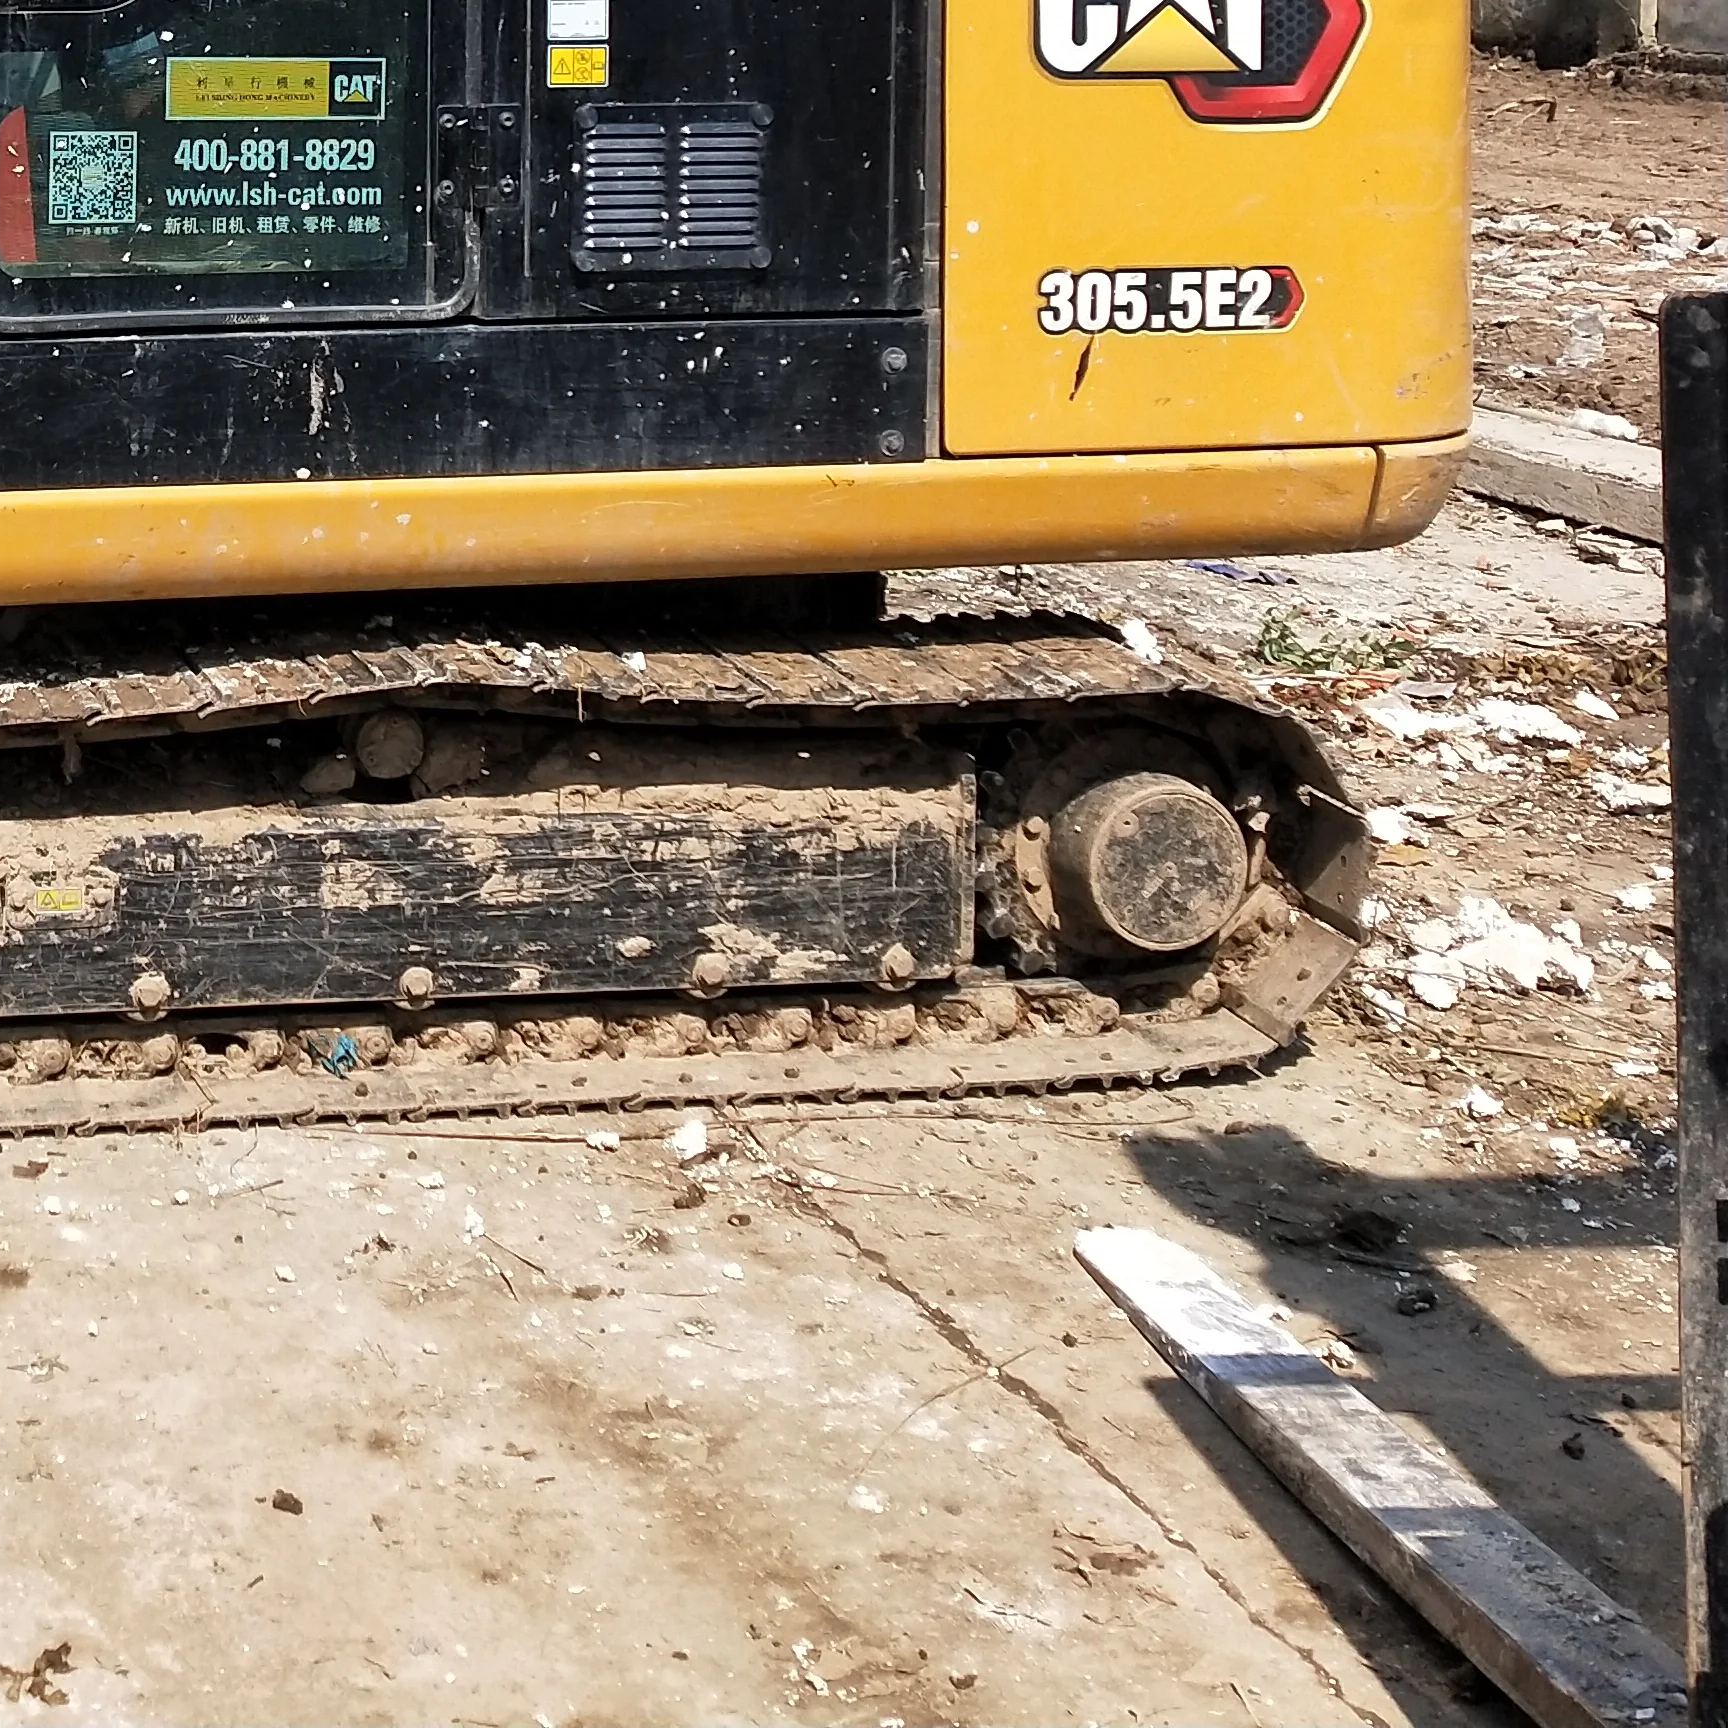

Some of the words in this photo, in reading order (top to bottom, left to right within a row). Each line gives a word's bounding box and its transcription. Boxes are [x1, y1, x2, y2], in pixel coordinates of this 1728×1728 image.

[334, 74, 377, 103] CAT
[174, 138, 375, 171] 400-881-8829
[164, 180, 382, 207] www.lsh-cat.com
[1039, 269, 1272, 331] 305.5E2
